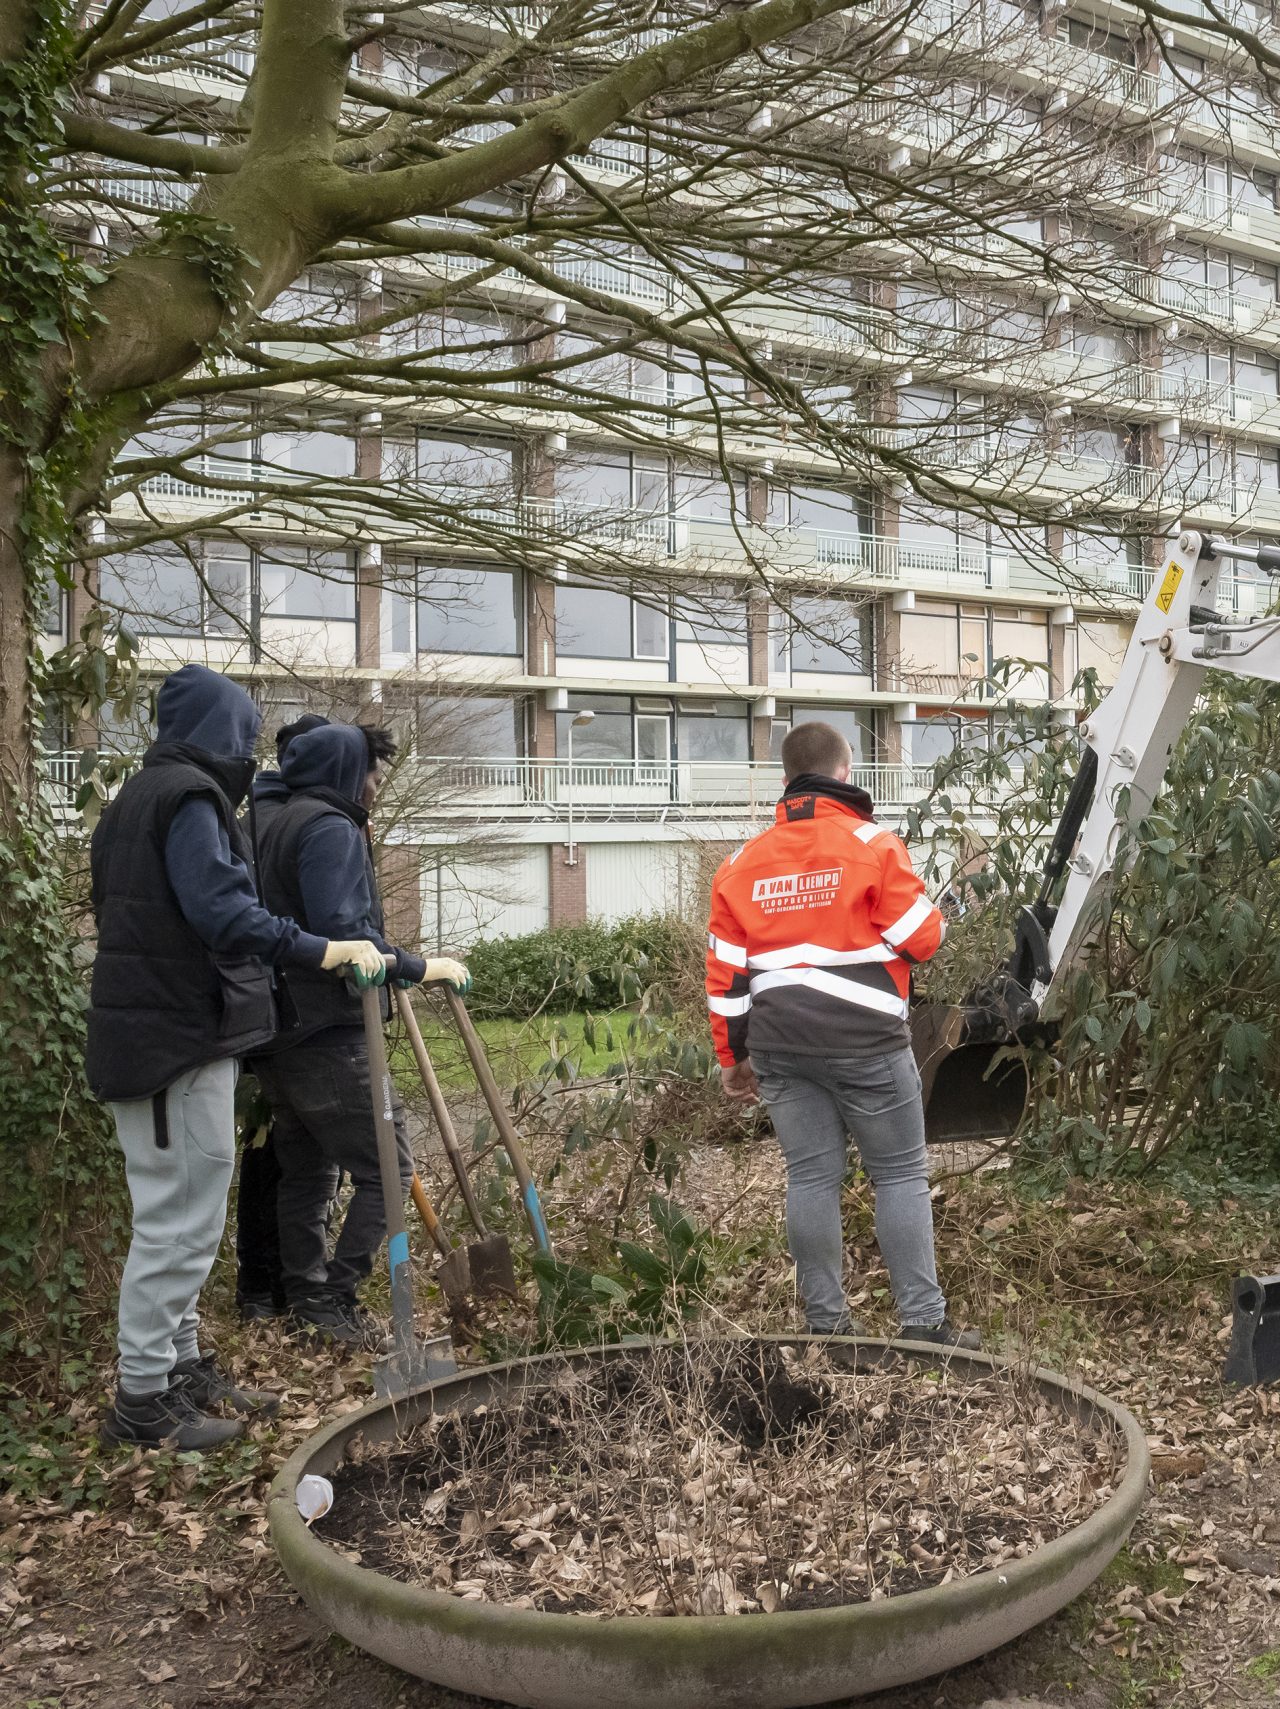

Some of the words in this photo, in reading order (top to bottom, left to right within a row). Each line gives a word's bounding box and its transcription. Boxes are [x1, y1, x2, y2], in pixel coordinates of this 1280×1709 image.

[758, 884, 766, 896] A
[769, 879, 793, 894] VAN
[799, 872, 839, 890] LIEMPD
